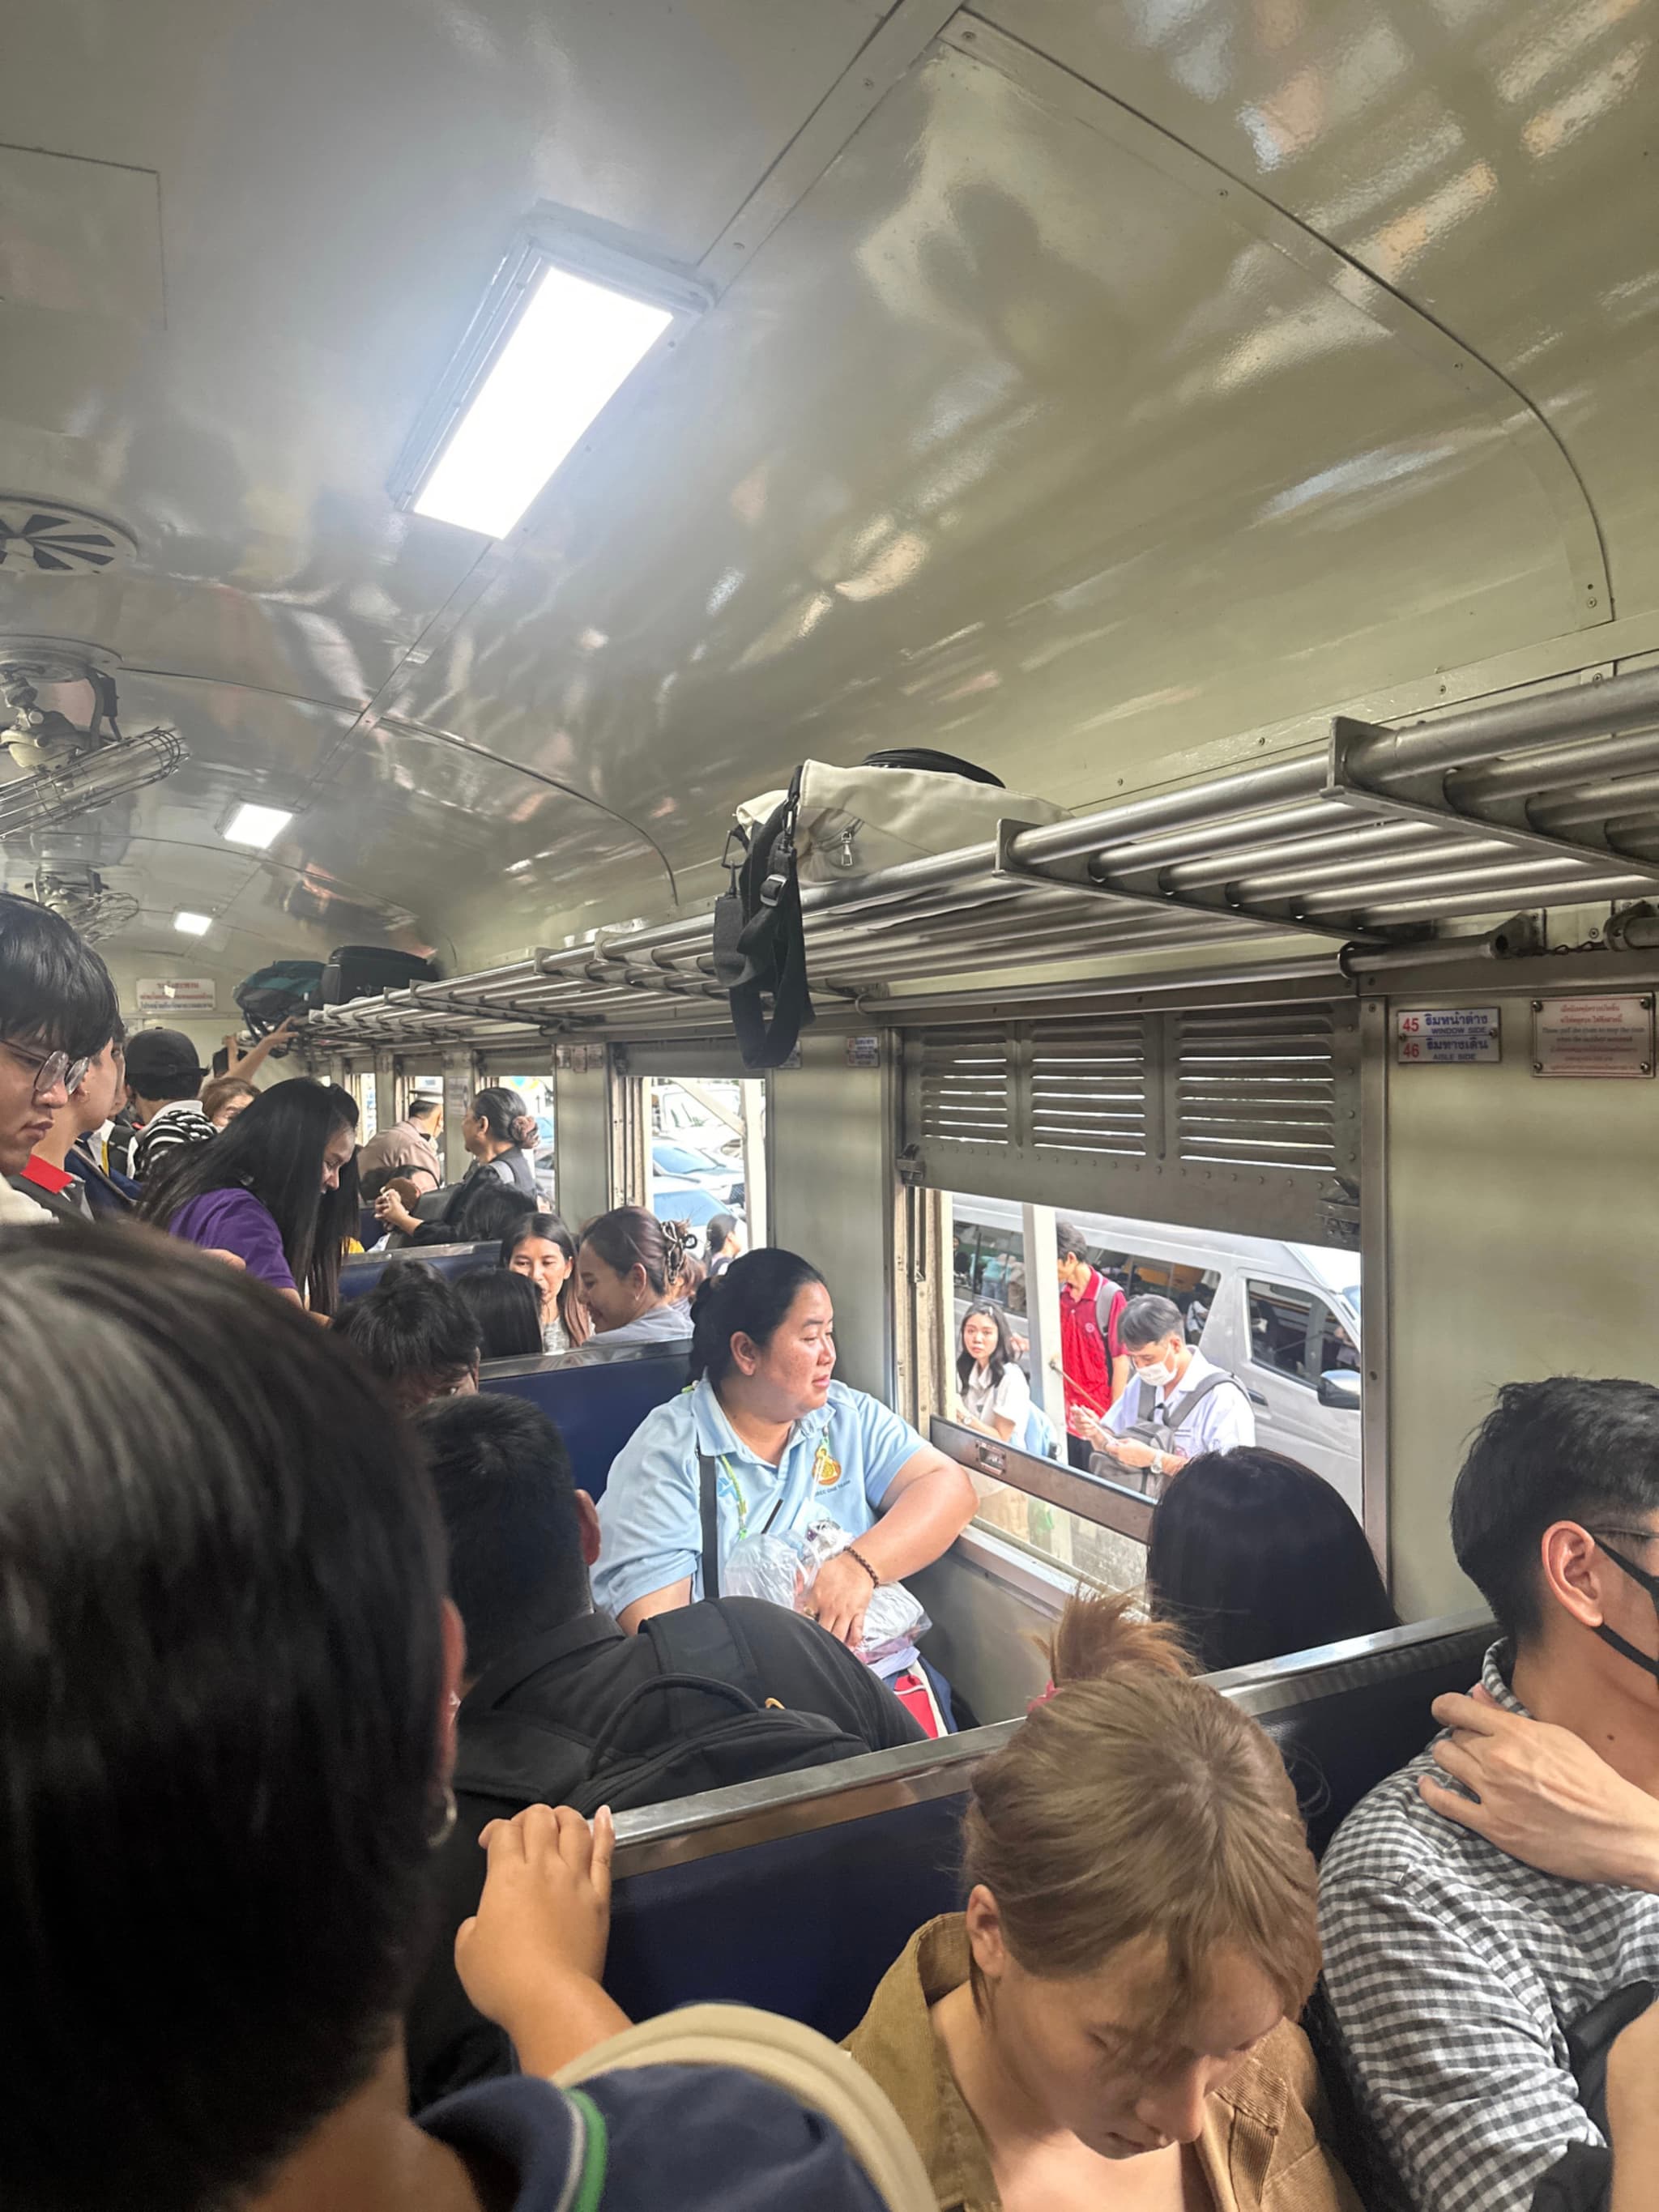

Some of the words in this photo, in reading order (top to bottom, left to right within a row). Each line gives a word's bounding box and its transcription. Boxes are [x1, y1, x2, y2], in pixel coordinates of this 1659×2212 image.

[1402, 1017, 1419, 1032] 45
[1425, 1012, 1488, 1025] ริมหน้าต่าง
[1403, 1043, 1419, 1058] 46
[1426, 1038, 1489, 1051] ริมทางเดิน
